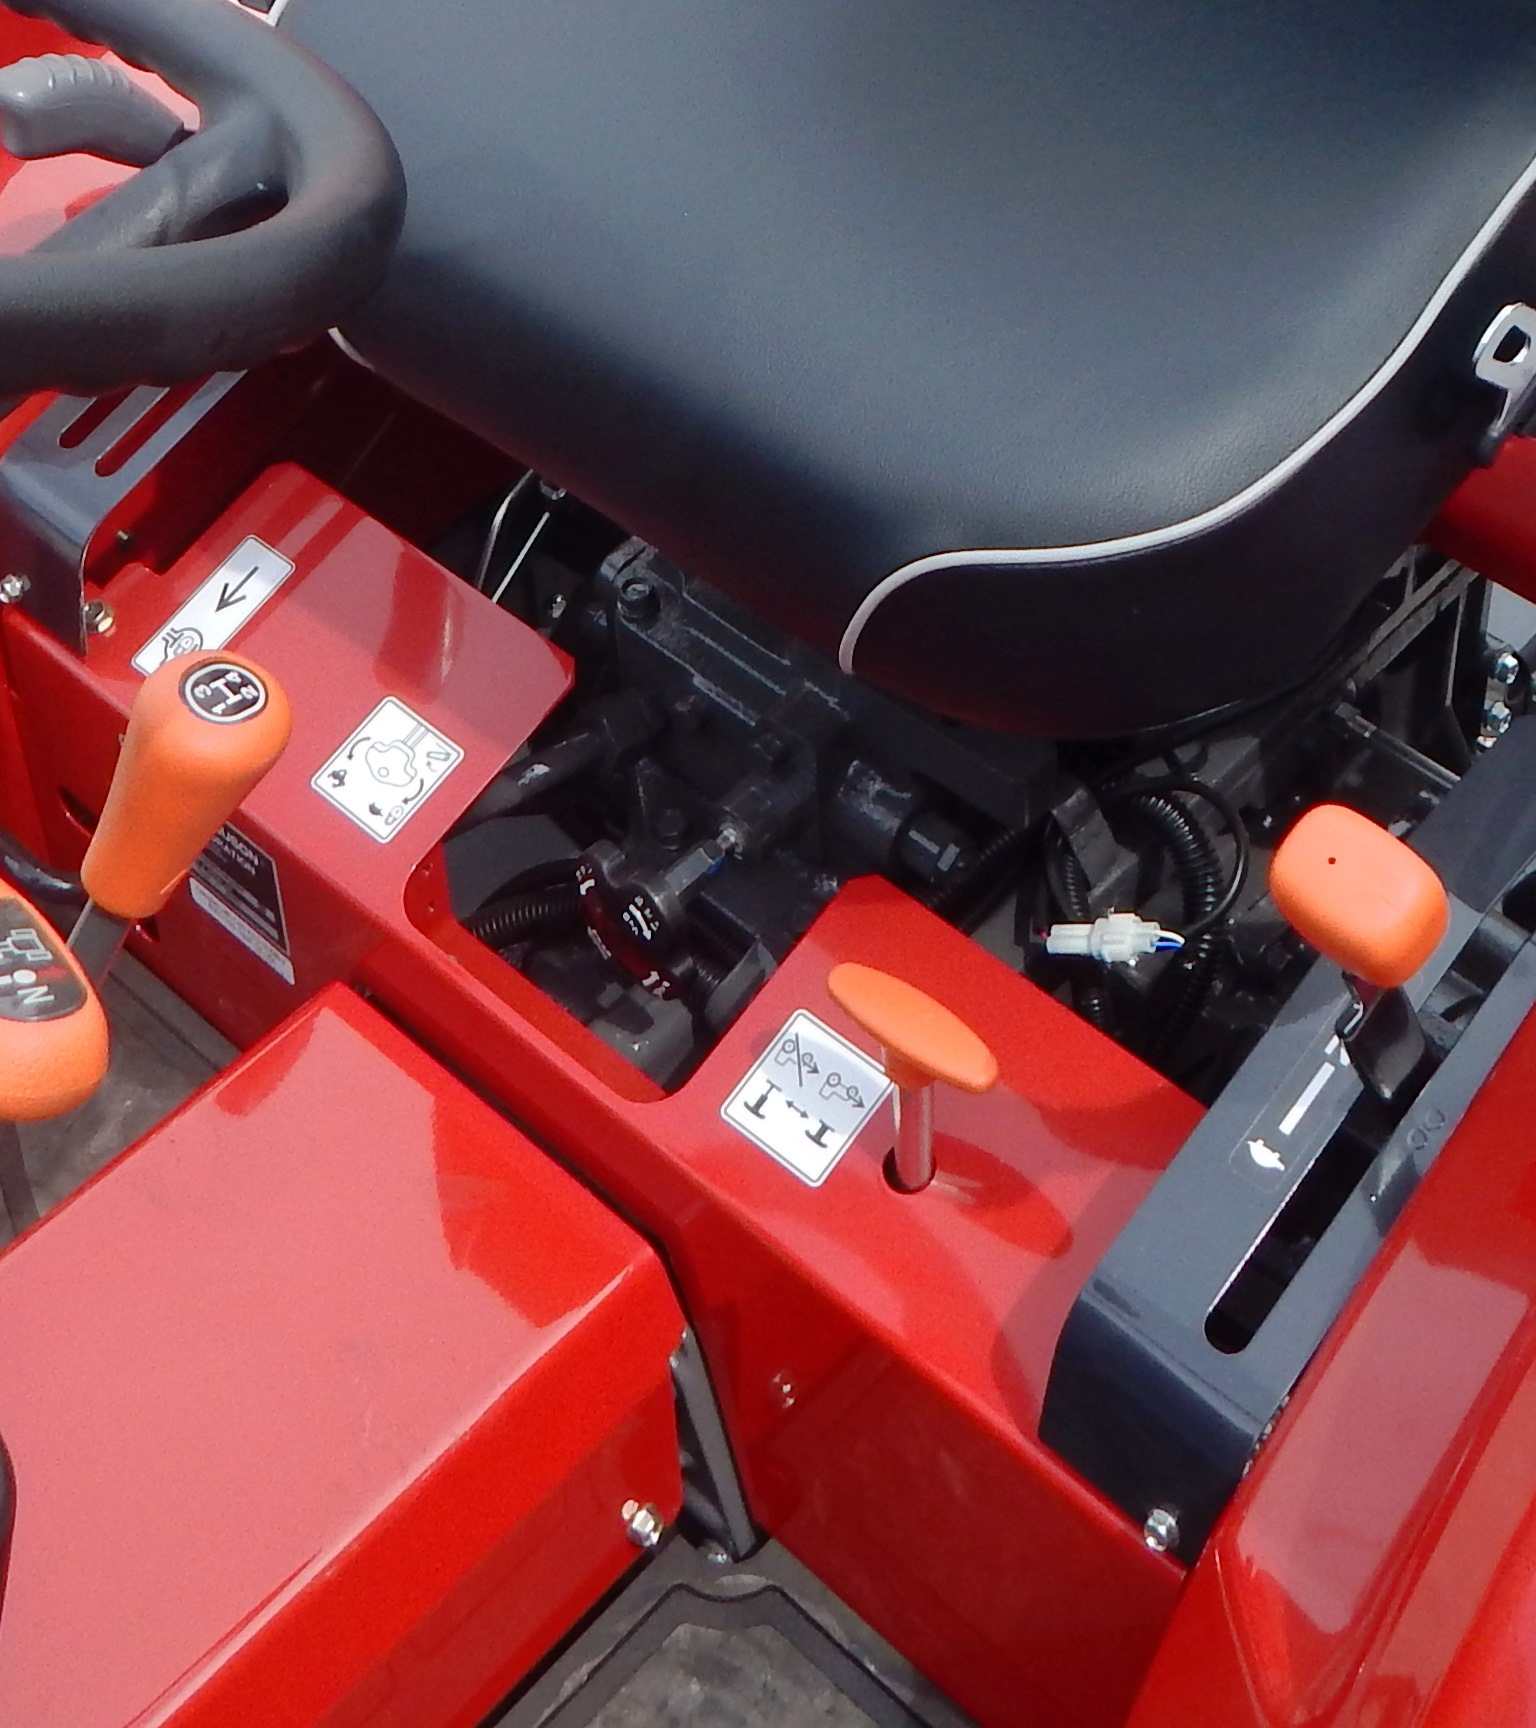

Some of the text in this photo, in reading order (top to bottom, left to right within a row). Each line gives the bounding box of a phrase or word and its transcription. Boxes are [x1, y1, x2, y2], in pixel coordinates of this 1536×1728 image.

[194, 683, 212, 699] 3
[240, 684, 259, 700] 2
[17, 984, 55, 1005] N
